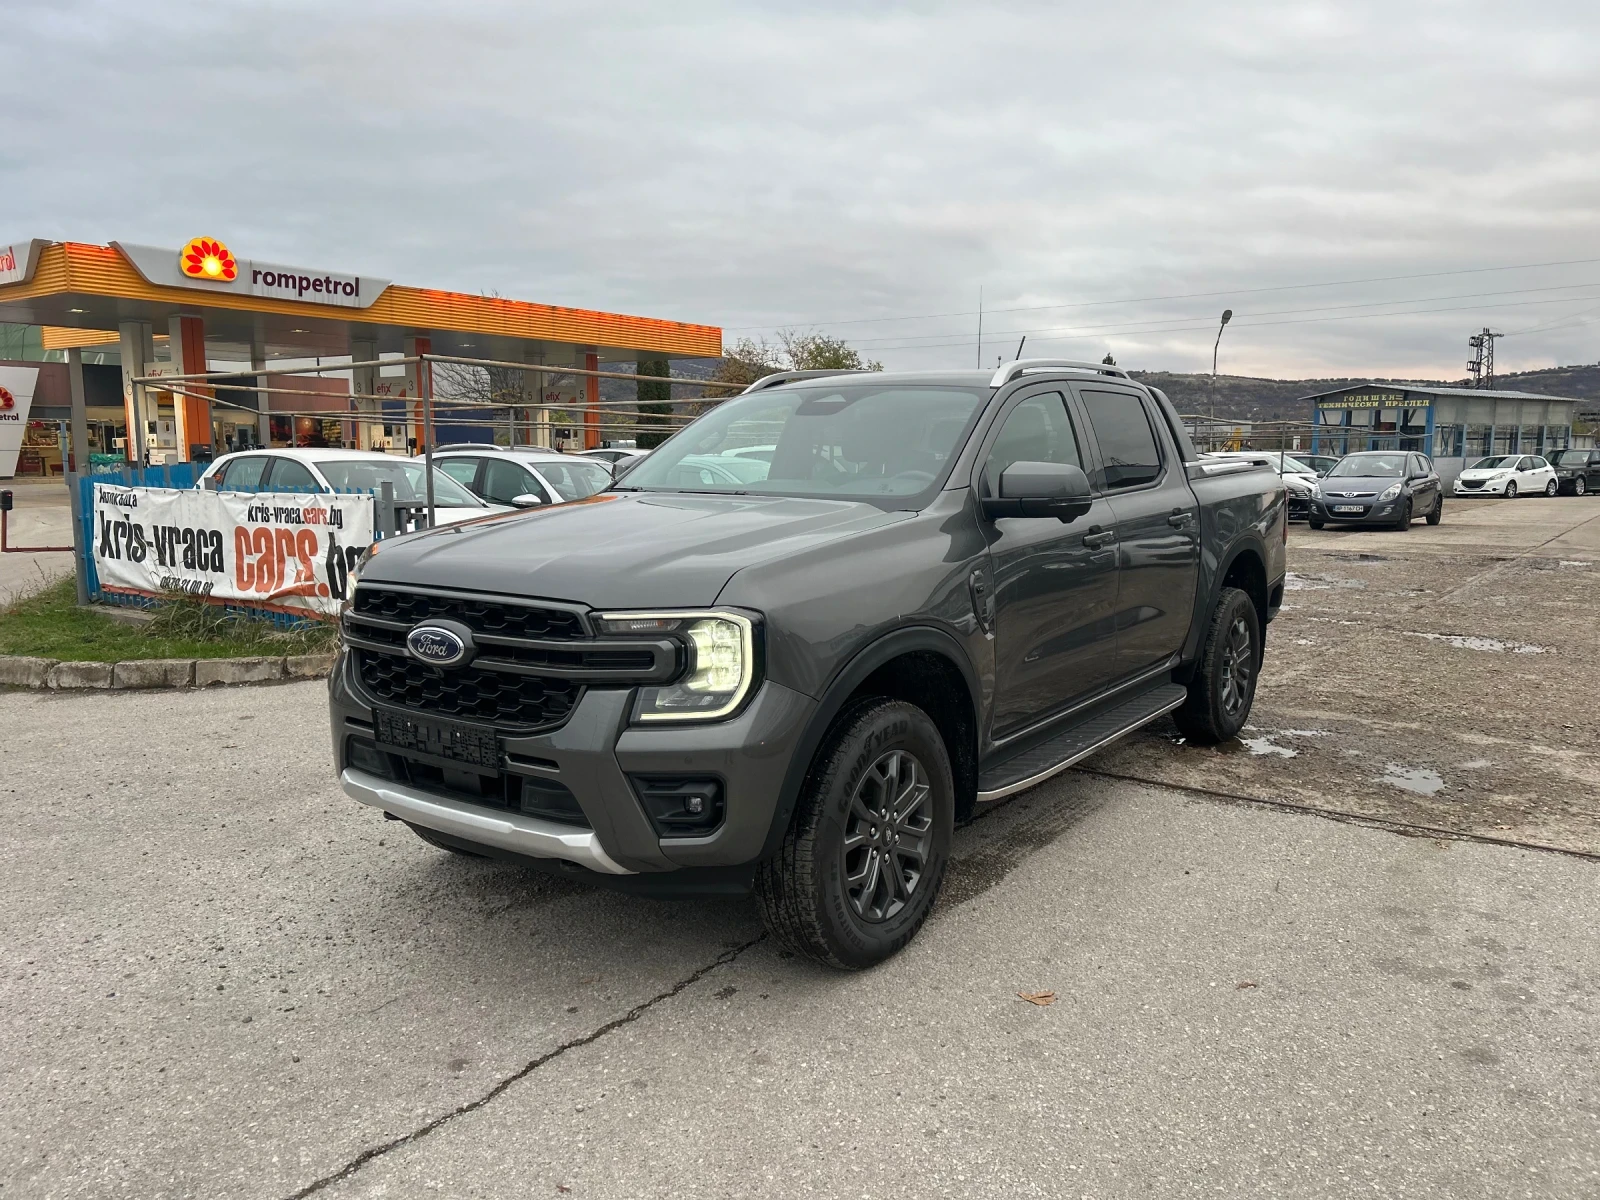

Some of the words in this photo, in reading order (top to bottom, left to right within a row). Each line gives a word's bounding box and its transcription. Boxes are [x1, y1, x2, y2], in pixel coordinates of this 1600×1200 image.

[252, 269, 360, 297] rompetrol
[376, 382, 392, 396] efix
[545, 391, 561, 403] efix
[1385, 399, 1430, 407] ПРЕГЛЕД
[99, 485, 138, 509] Автокъща
[247, 502, 343, 530] kris-vraca.cars.bg
[99, 510, 225, 573] kris-vraca
[417, 633, 449, 656] Ford
[837, 720, 909, 814] GOODYEAR
